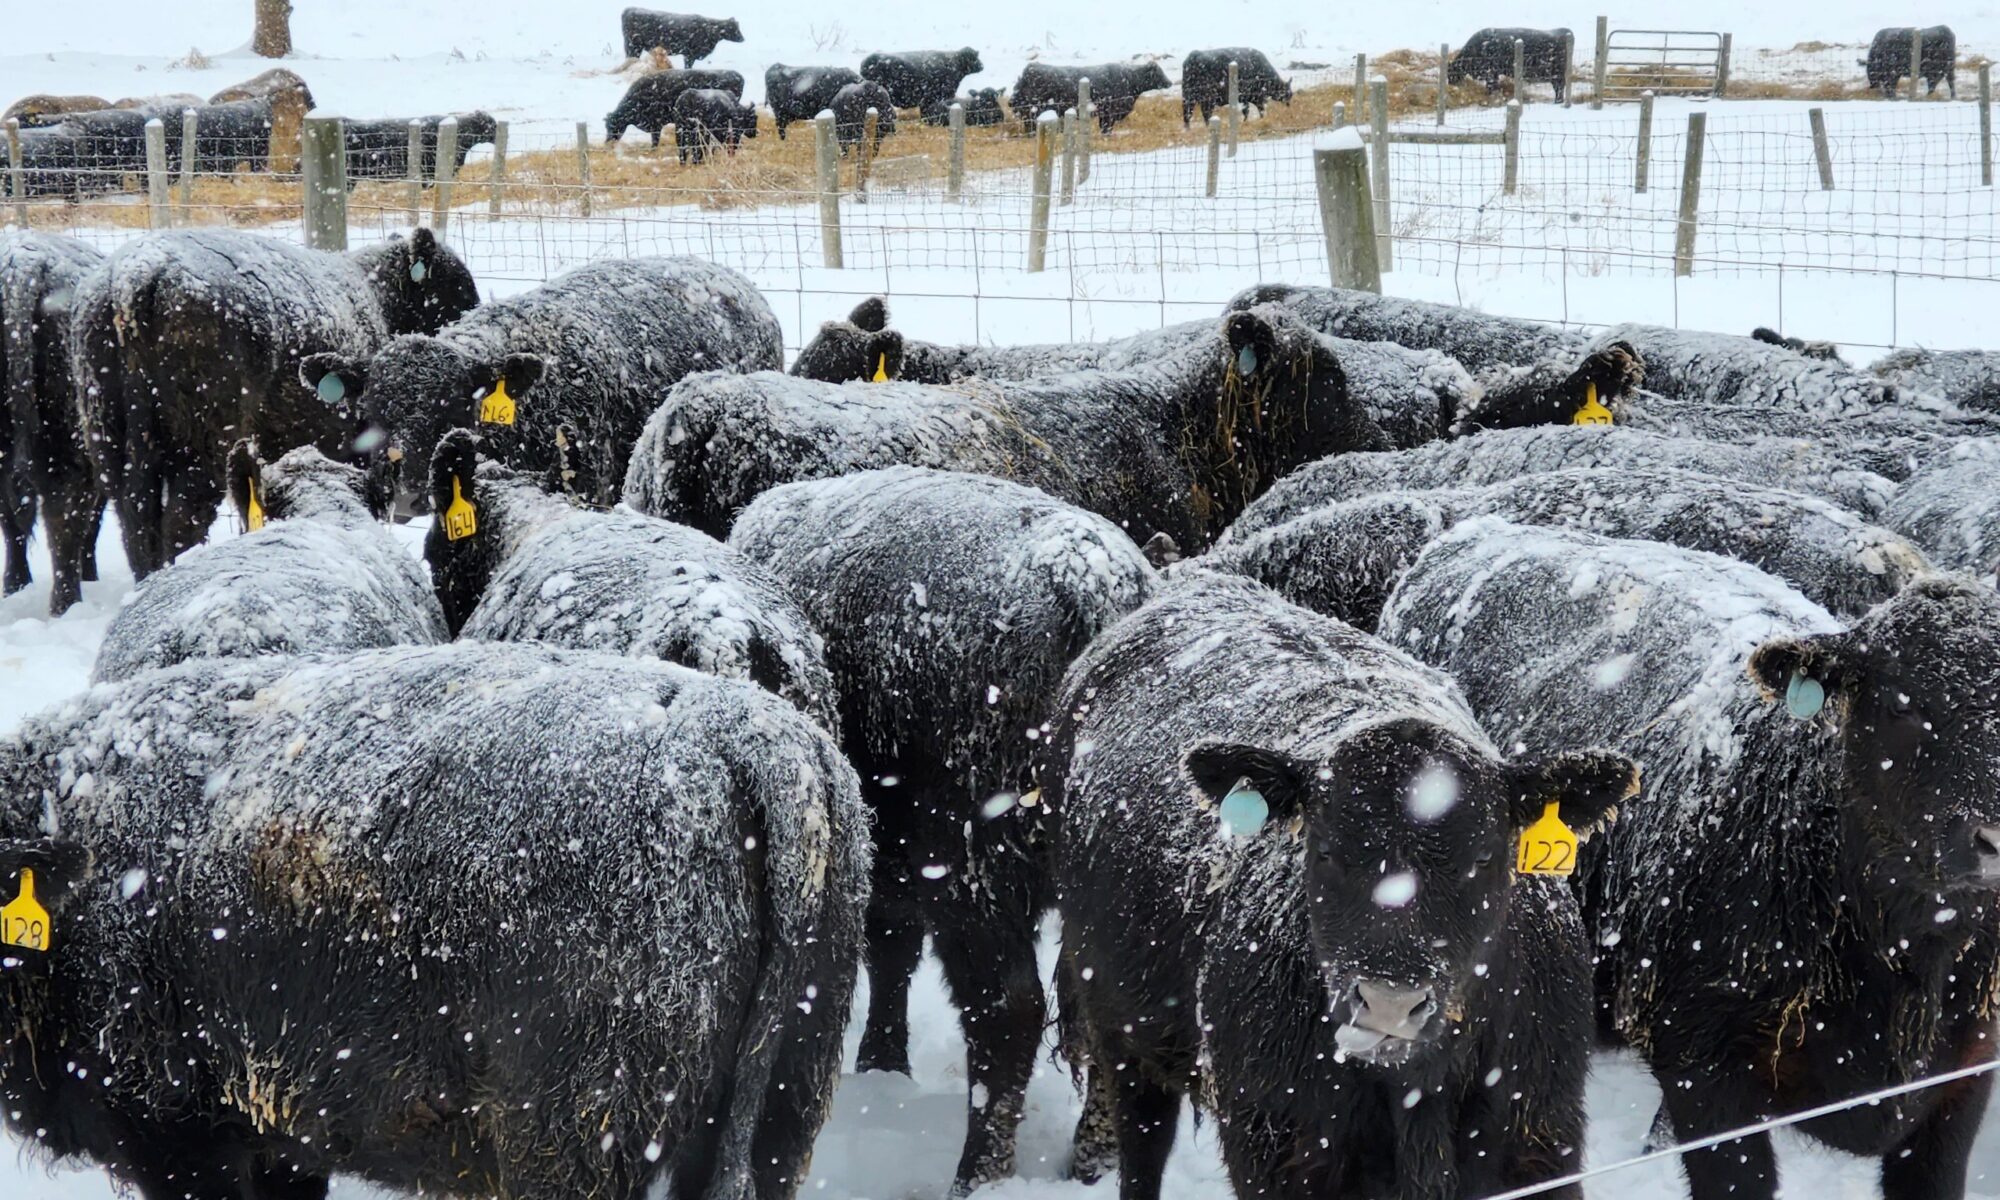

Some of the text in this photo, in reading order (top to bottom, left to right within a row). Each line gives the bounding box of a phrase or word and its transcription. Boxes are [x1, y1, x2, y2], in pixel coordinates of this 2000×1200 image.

[449, 511, 473, 539] 164
[1522, 840, 1572, 871] 122
[4, 916, 43, 949] 128
